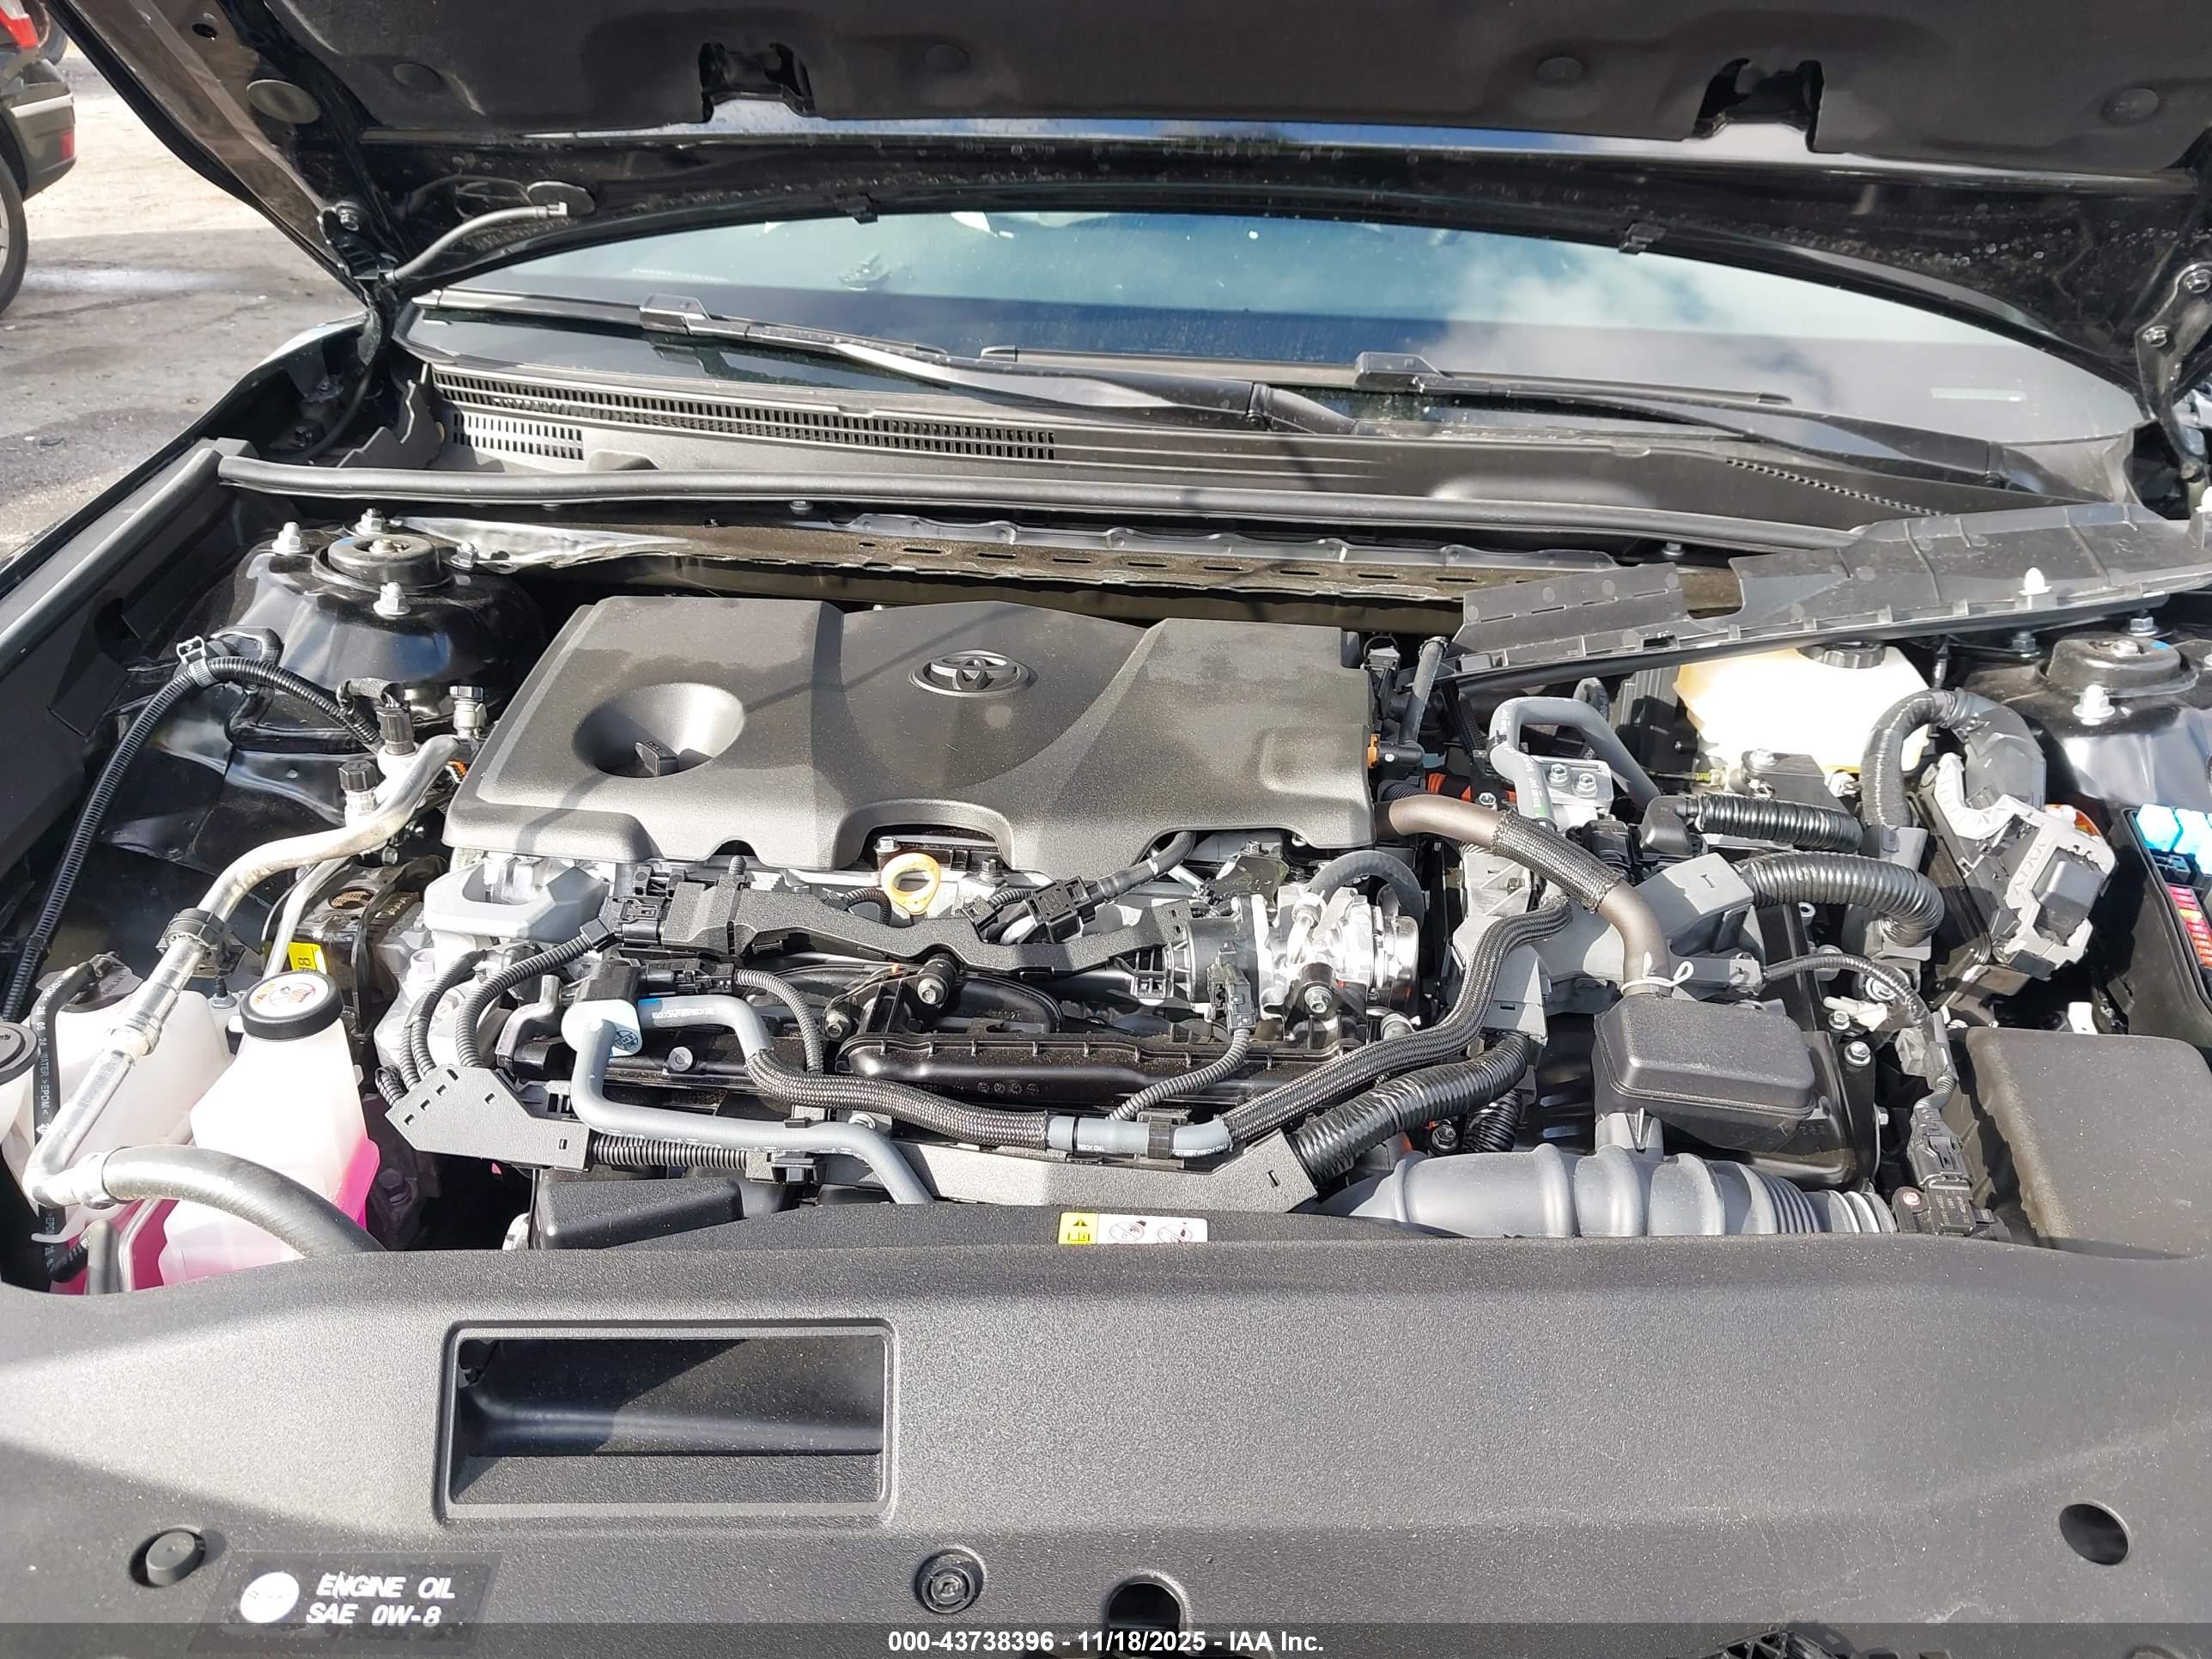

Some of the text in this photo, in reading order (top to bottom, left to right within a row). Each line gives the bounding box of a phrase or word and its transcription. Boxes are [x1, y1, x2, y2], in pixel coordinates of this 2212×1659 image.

[316, 1571, 406, 1598] ENGINE
[417, 1577, 456, 1598] OIL
[306, 1602, 442, 1627] SAE 0W-8
